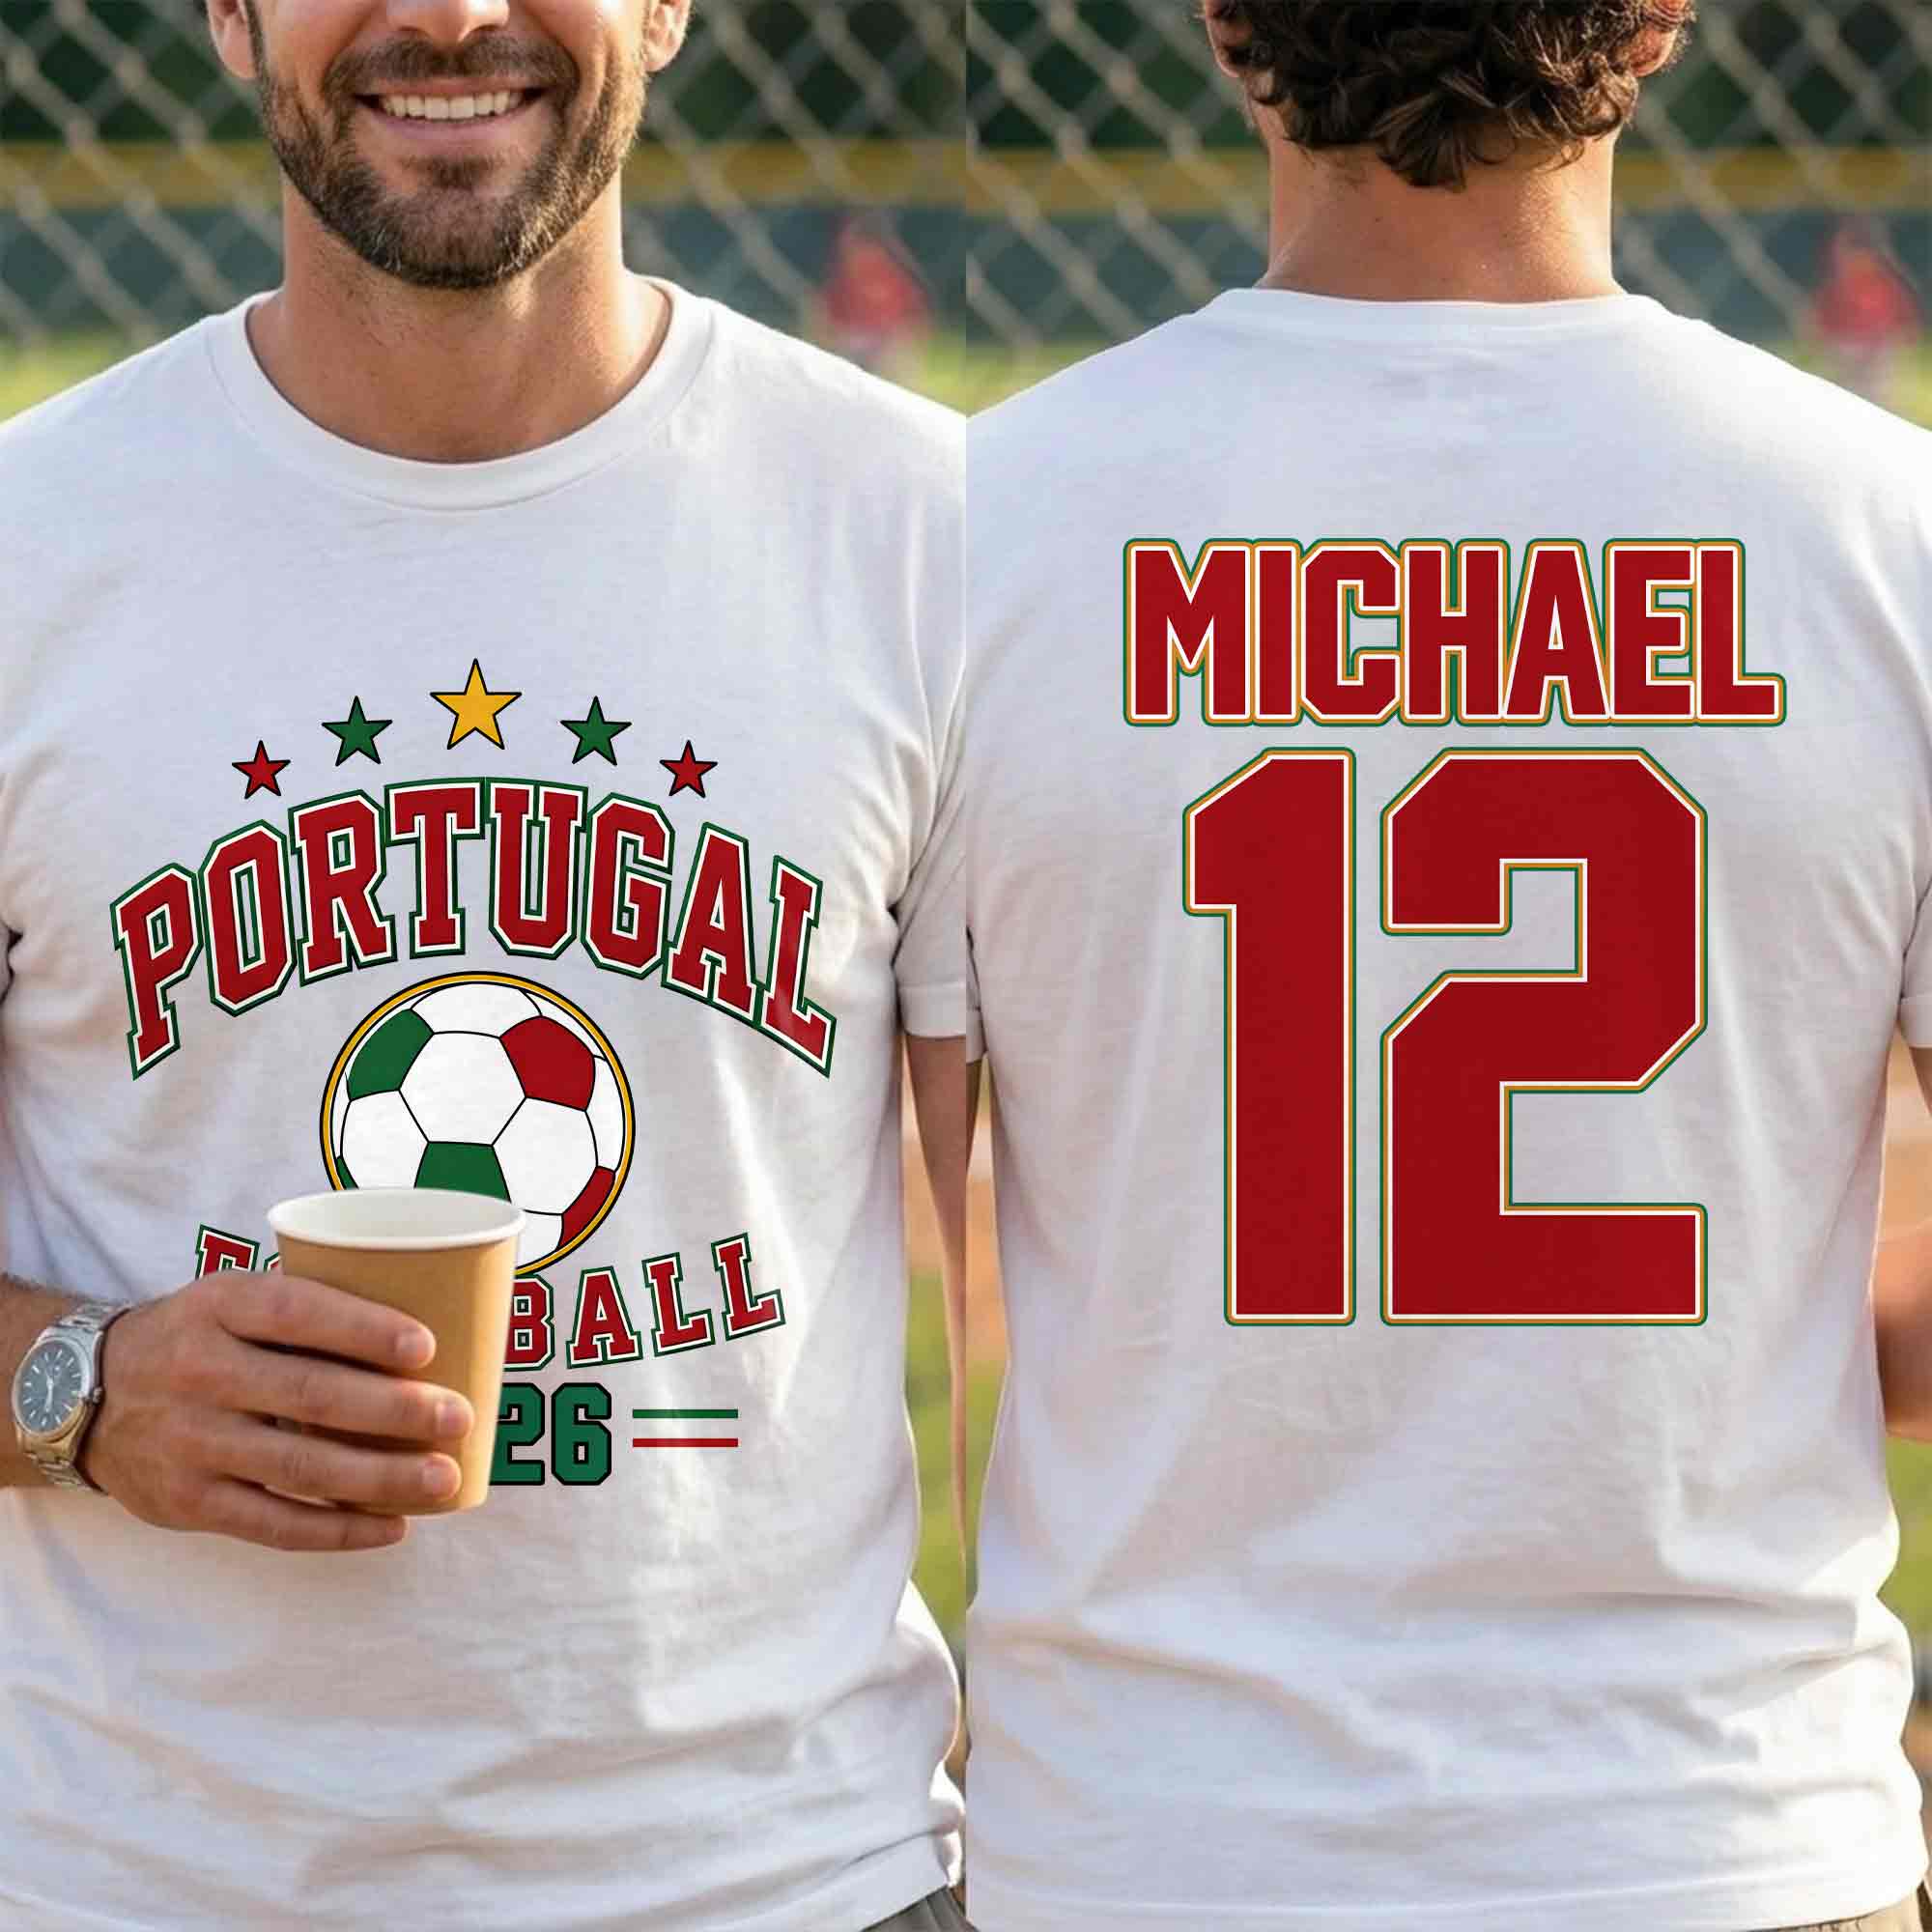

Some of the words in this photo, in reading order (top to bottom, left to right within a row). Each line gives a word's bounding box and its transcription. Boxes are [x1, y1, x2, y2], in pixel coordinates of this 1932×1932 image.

[1124, 539, 1785, 725] MICHAEL
[110, 777, 837, 1079] PORTUGAL
[1183, 748, 1707, 1326] 12
[195, 1224, 785, 1371] FBALL
